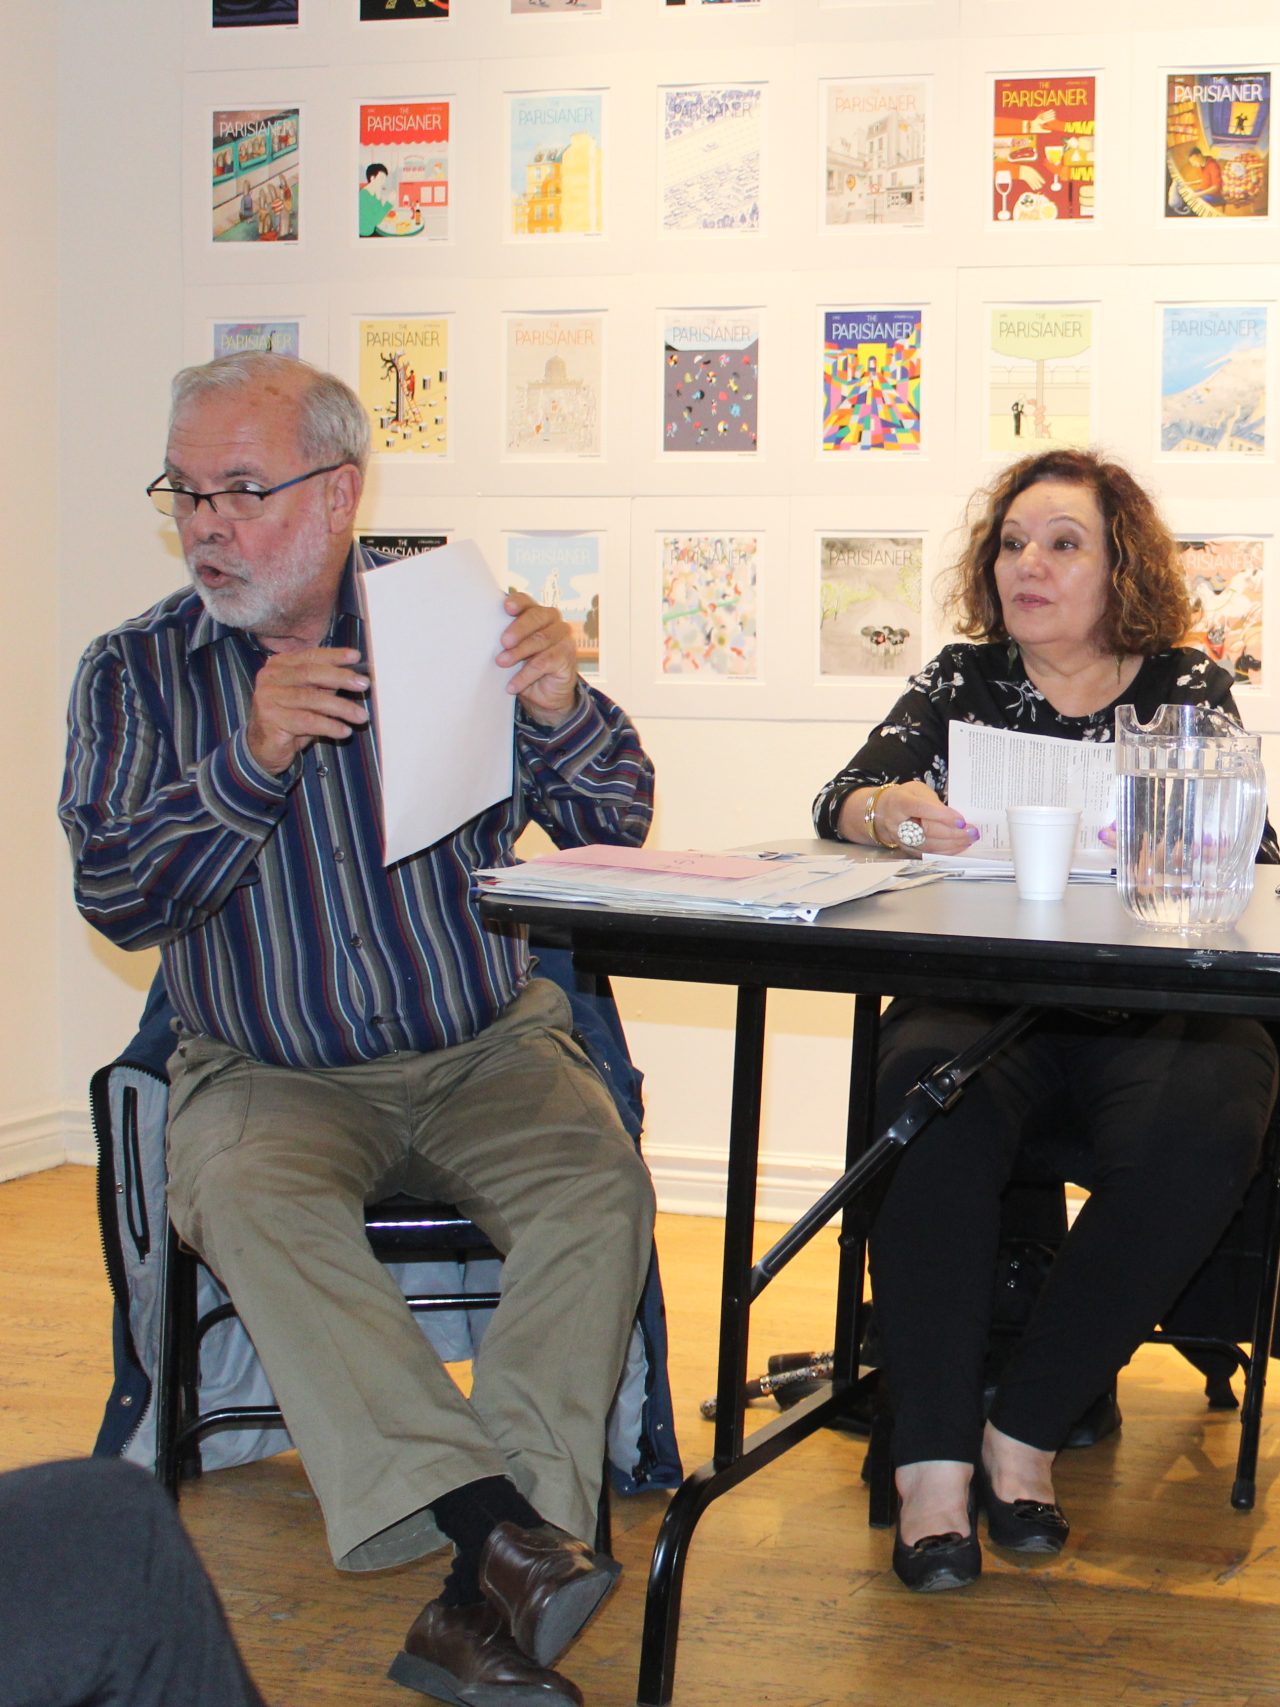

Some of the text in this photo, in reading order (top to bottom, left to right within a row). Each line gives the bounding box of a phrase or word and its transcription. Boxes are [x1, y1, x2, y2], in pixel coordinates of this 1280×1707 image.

[1002, 88, 1088, 108] PARISIANER
[1174, 83, 1264, 104] PARISIANER
[835, 95, 916, 113] PARISIANER
[367, 114, 442, 132] PARISIANER
[518, 107, 593, 126] PARISIANER
[515, 329, 595, 346] PARISIANER
[672, 325, 750, 343] PARISIANER
[831, 322, 912, 341] PARISIANER
[999, 320, 1083, 339] PARISIANER
[1170, 319, 1259, 338] PARISIANER
[366, 331, 439, 348] PARISIANER
[829, 549, 914, 567] PARISIANER
